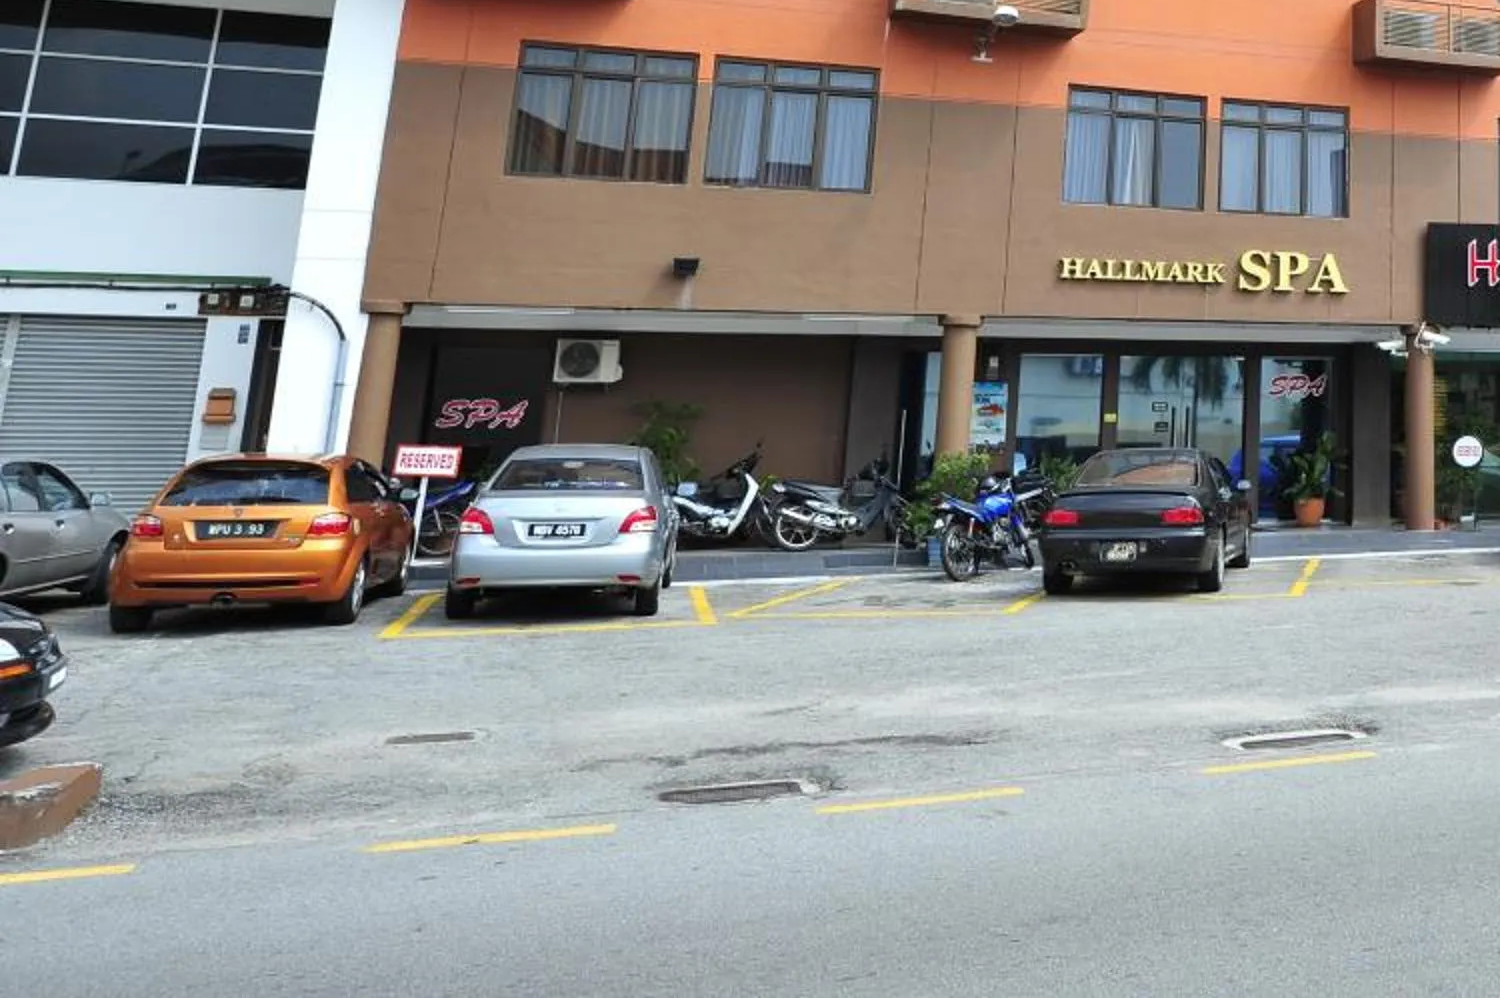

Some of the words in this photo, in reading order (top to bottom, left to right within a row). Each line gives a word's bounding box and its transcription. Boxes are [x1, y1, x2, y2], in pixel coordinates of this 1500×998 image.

[1058, 257, 1228, 284] HALLMARK
[1238, 249, 1350, 294] SPA
[1269, 373, 1327, 398] SPA
[435, 398, 529, 429] SPA
[399, 452, 454, 469] RESERVED
